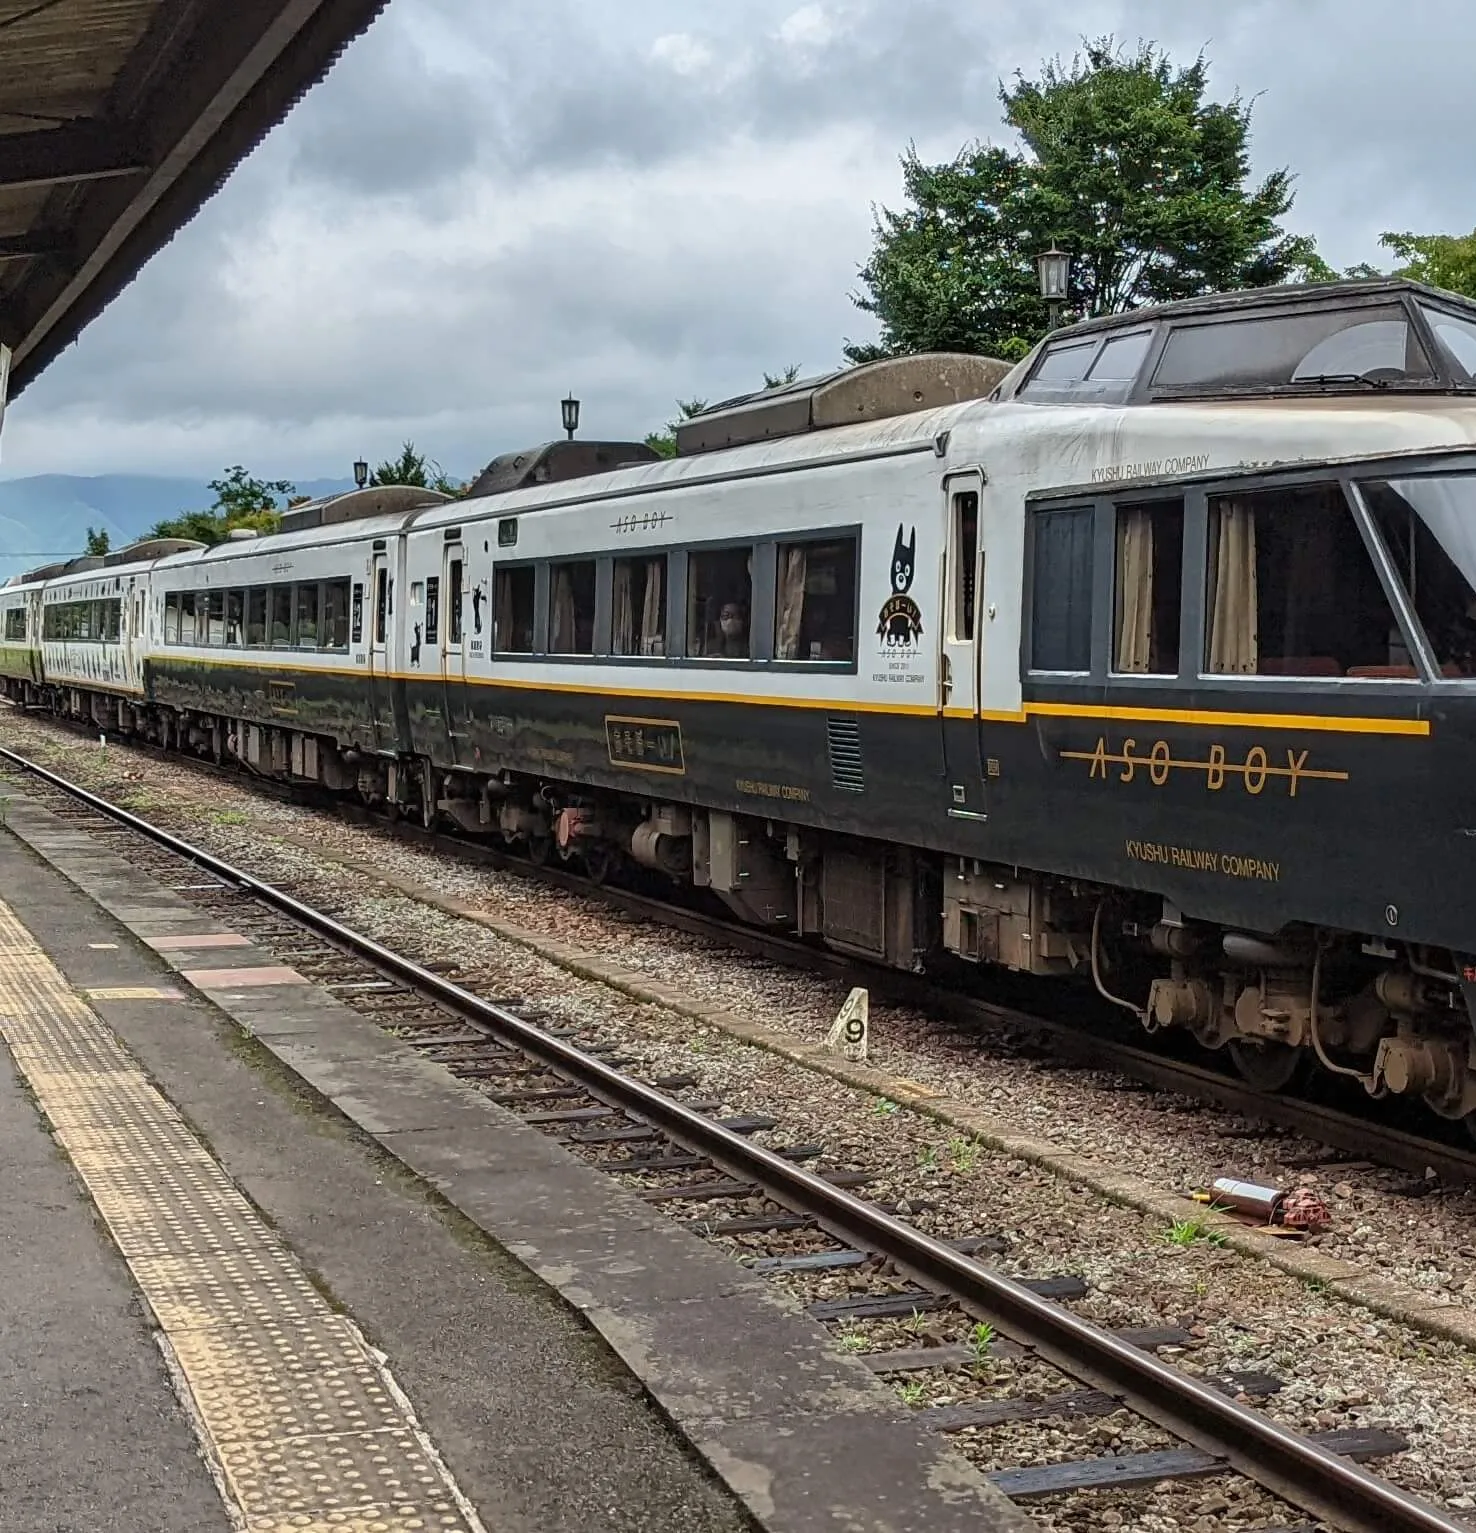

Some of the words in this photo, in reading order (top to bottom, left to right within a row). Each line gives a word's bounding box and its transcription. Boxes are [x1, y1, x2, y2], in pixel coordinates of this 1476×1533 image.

[1091, 465, 1124, 483] KYUSHU
[1126, 460, 1162, 478] RAILWAY
[1164, 454, 1210, 474] COMPANY
[1089, 737, 1170, 786] ASO
[1207, 744, 1309, 797] BOY
[1125, 839, 1168, 865] KYUSHU
[1171, 847, 1219, 873] RAILWAY
[1221, 855, 1280, 882] COMPANY
[845, 1019, 865, 1043] 9
